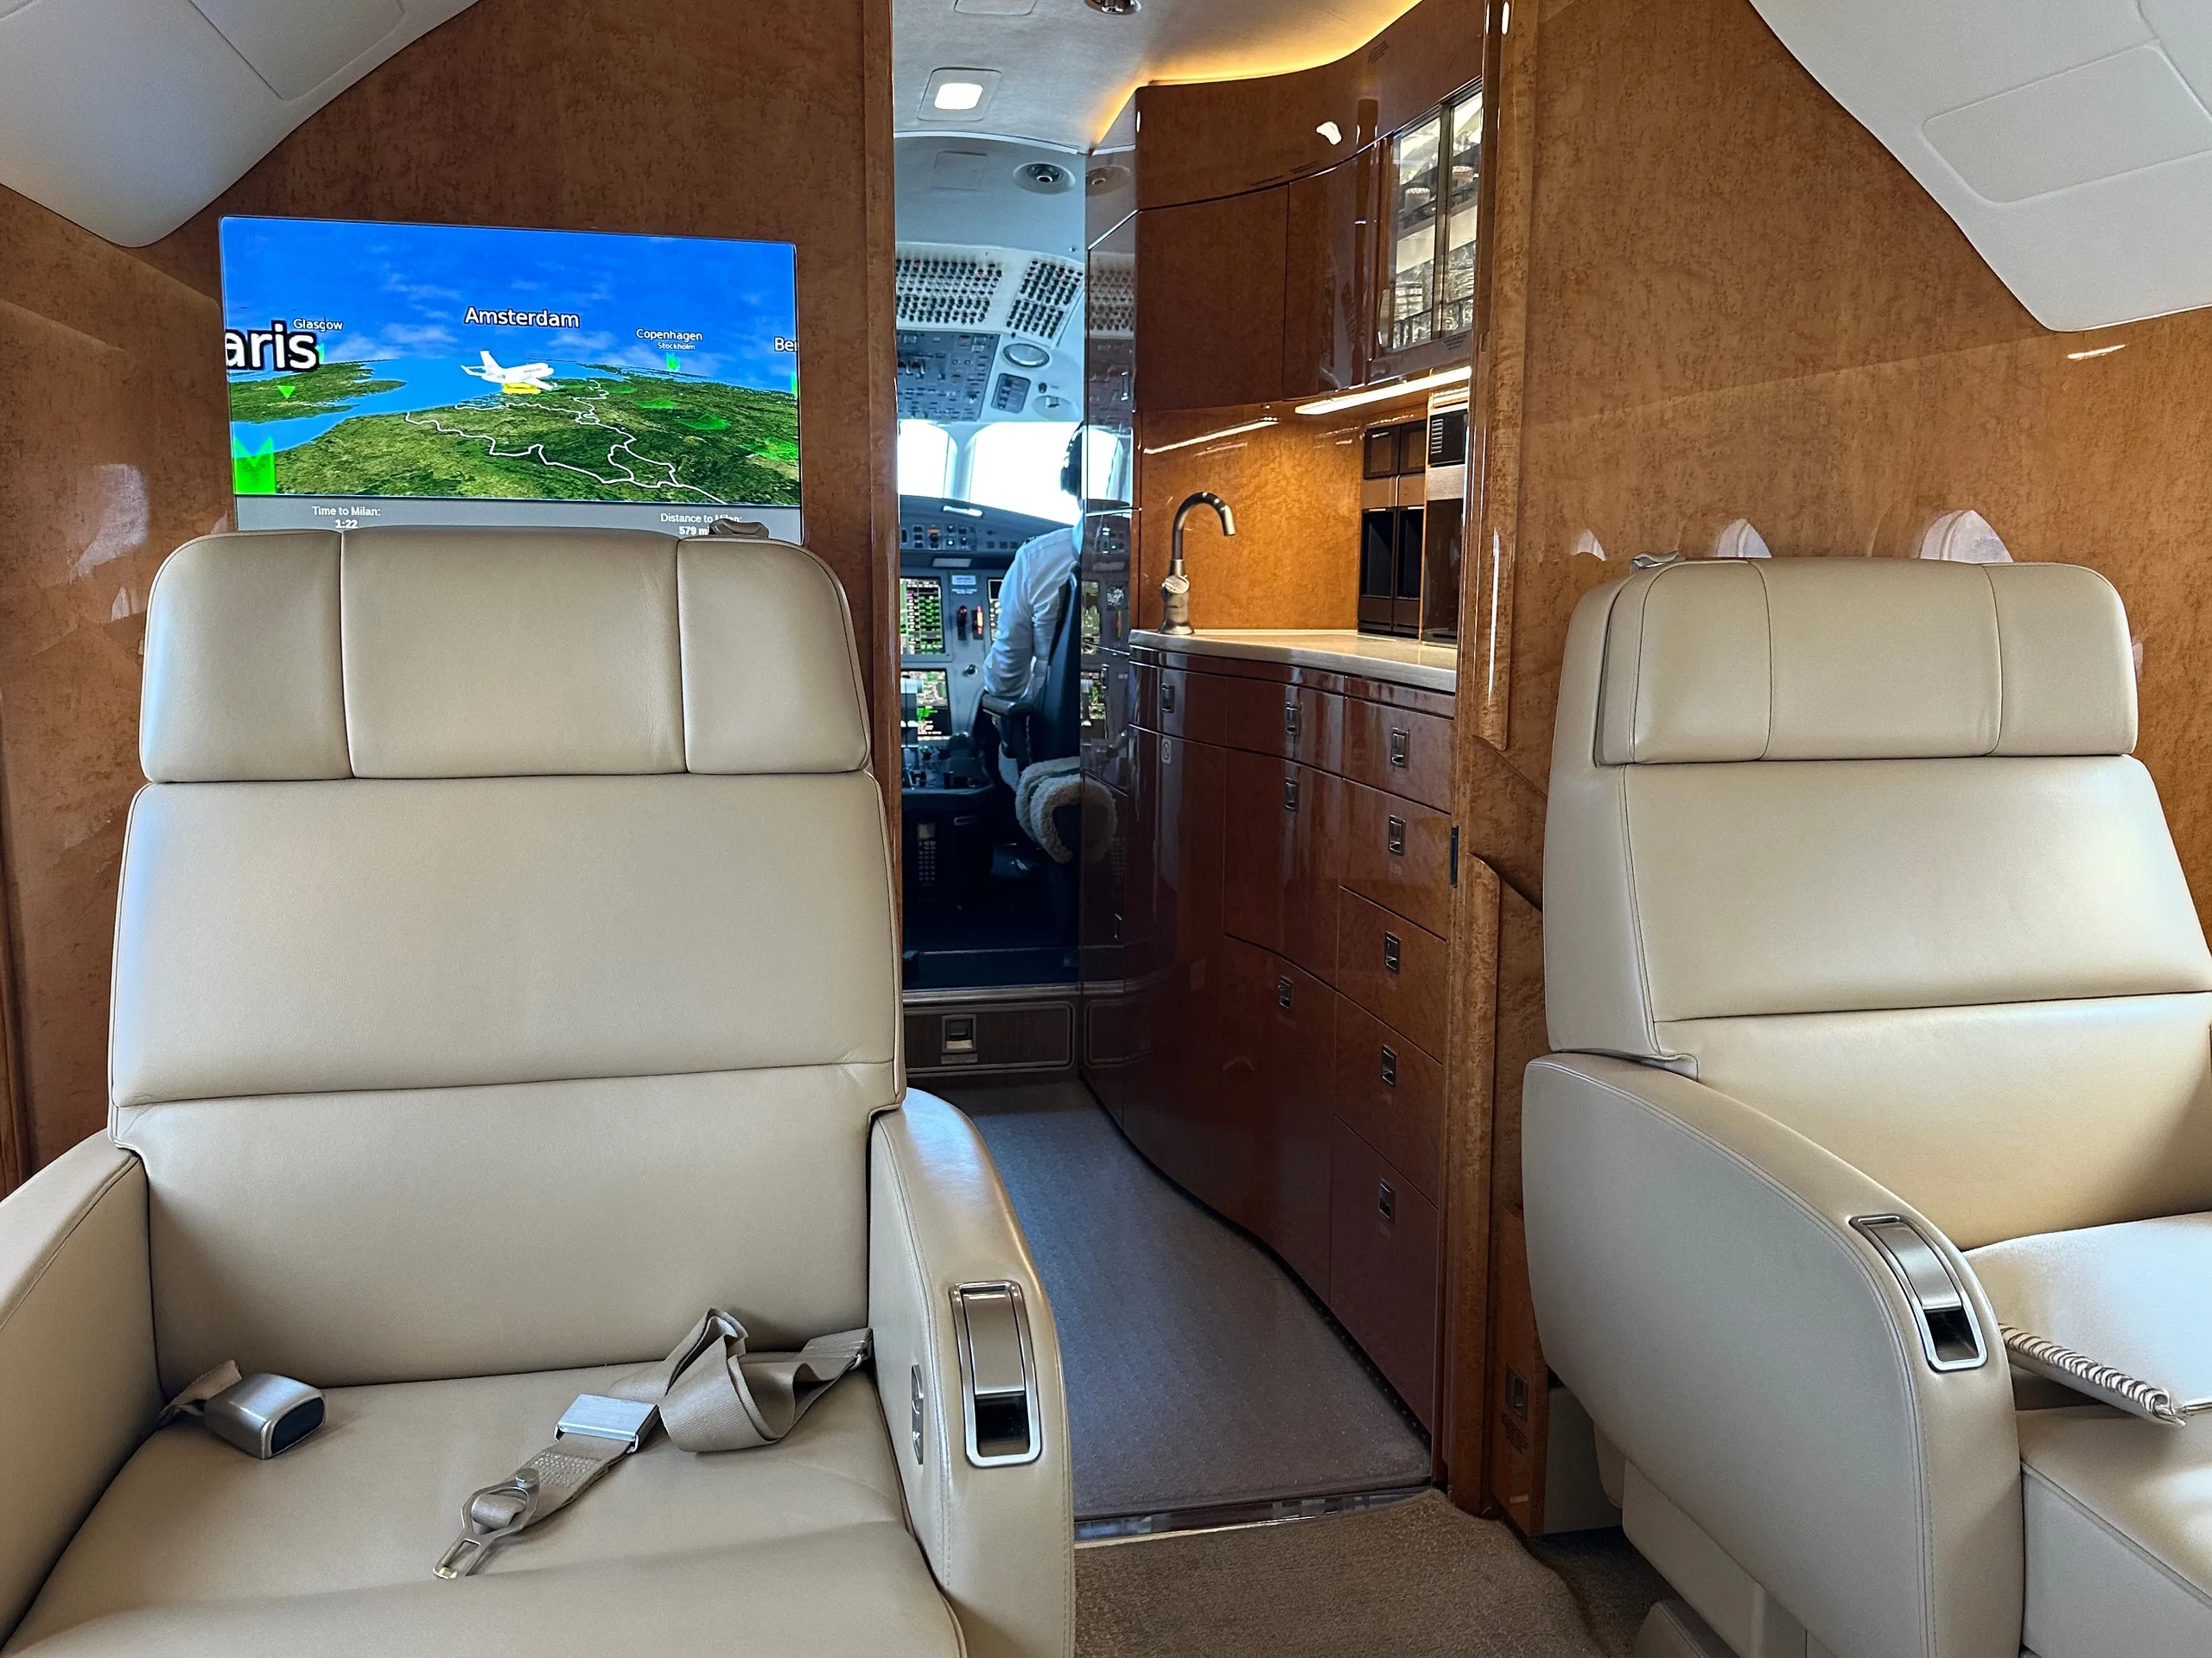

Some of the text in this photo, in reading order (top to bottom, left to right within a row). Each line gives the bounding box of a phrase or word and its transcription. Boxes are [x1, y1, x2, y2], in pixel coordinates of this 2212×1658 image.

[465, 307, 580, 327] Amsterdam
[293, 318, 343, 333] Glasgow
[636, 328, 703, 343] Copenhagen
[311, 505, 381, 517] Time to Milan:
[334, 518, 359, 529] 1:22
[660, 512, 702, 523] Distance
[703, 514, 714, 524] to
[678, 525, 697, 535] 579
